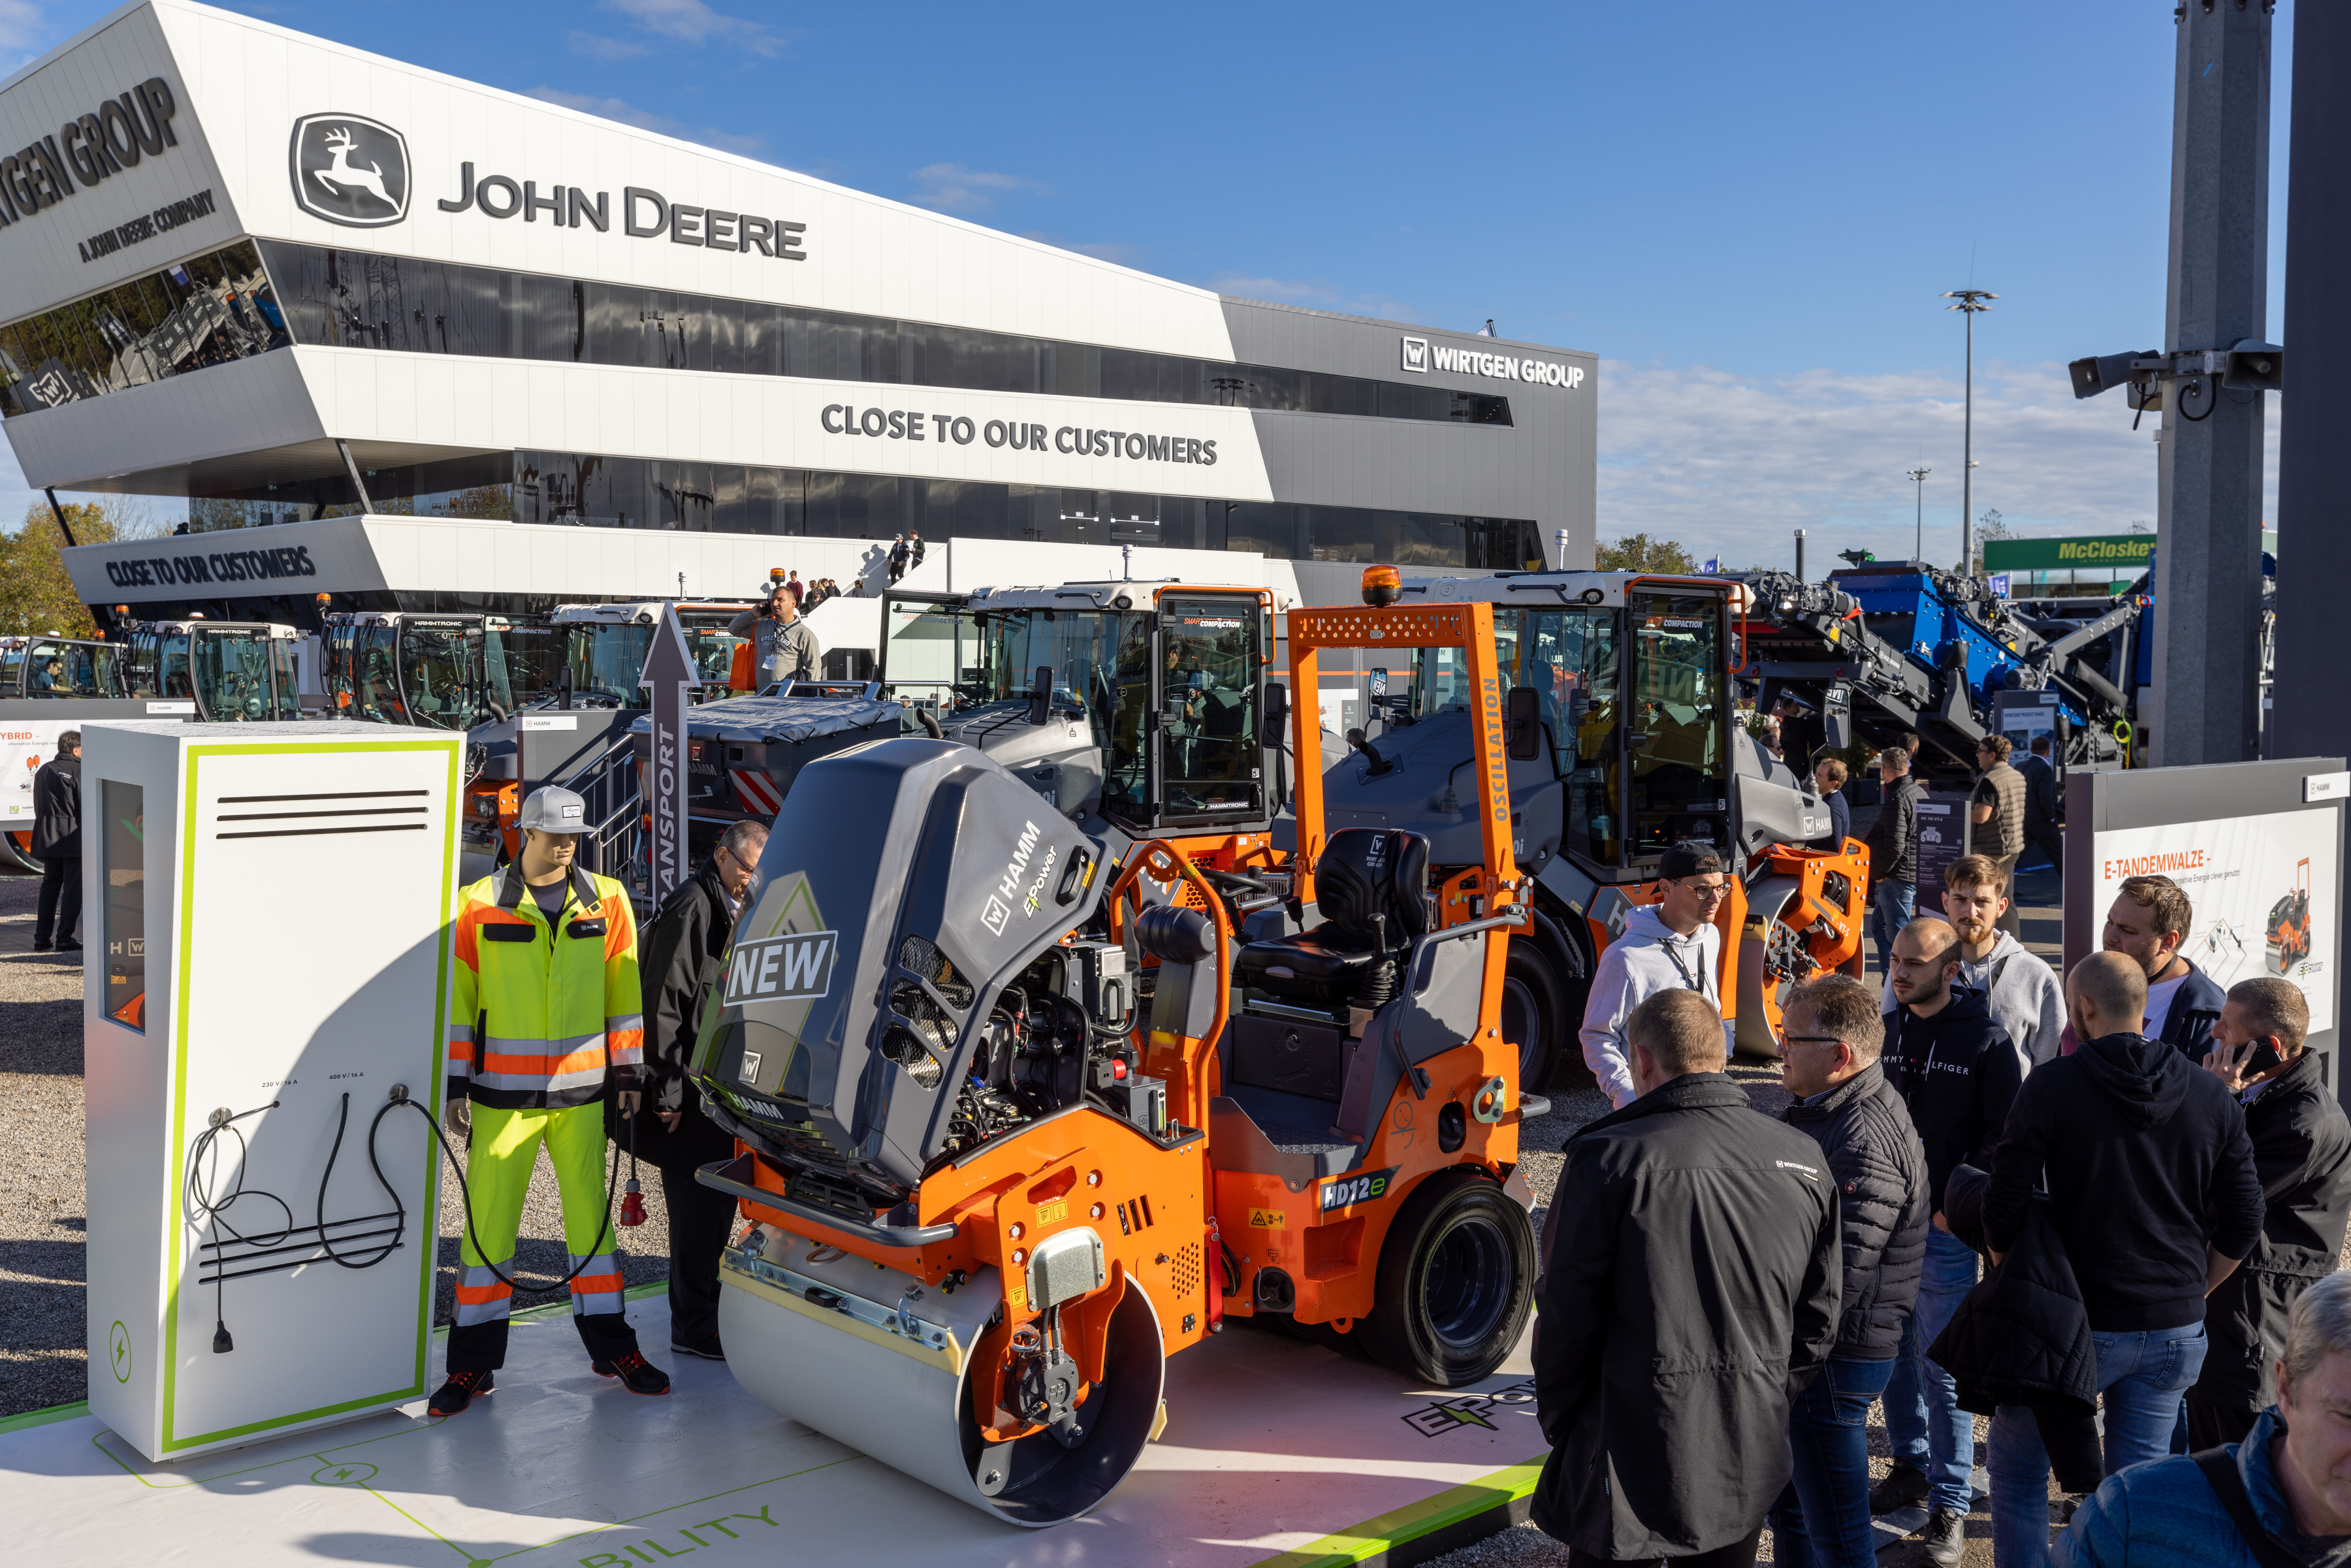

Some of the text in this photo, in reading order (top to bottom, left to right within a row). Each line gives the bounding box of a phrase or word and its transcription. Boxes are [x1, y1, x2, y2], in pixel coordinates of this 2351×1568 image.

[61, 77, 178, 187] GROUP
[78, 189, 216, 263] A JOHN DEERE COMPANY
[438, 161, 807, 261] JOHN DEERE
[1431, 346, 1518, 380] WIRTGEN
[1519, 359, 1584, 389] GROUP
[821, 403, 1218, 466] CLOSE TO OUR CUSTOMERS
[106, 545, 316, 588] CLOSE TO OUR CUSTOMERS
[1664, 619, 1703, 628] COMPACTION
[1482, 678, 1508, 822] OSCILLATION
[2316, 783, 2330, 792] HAMM
[659, 723, 675, 903] ANSPORT
[999, 820, 1041, 900] HAMM
[2105, 850, 2204, 880] E-TANDEMWALZE
[2193, 874, 2210, 883] Energie
[2224, 869, 2240, 878] genutzt
[729, 940, 830, 998] NEW
[728, 1092, 784, 1120] HAMM
[1783, 1162, 1804, 1170] WIRTGEN
[1803, 1166, 1818, 1174] GROUP
[1324, 1177, 1385, 1208] HD12e
